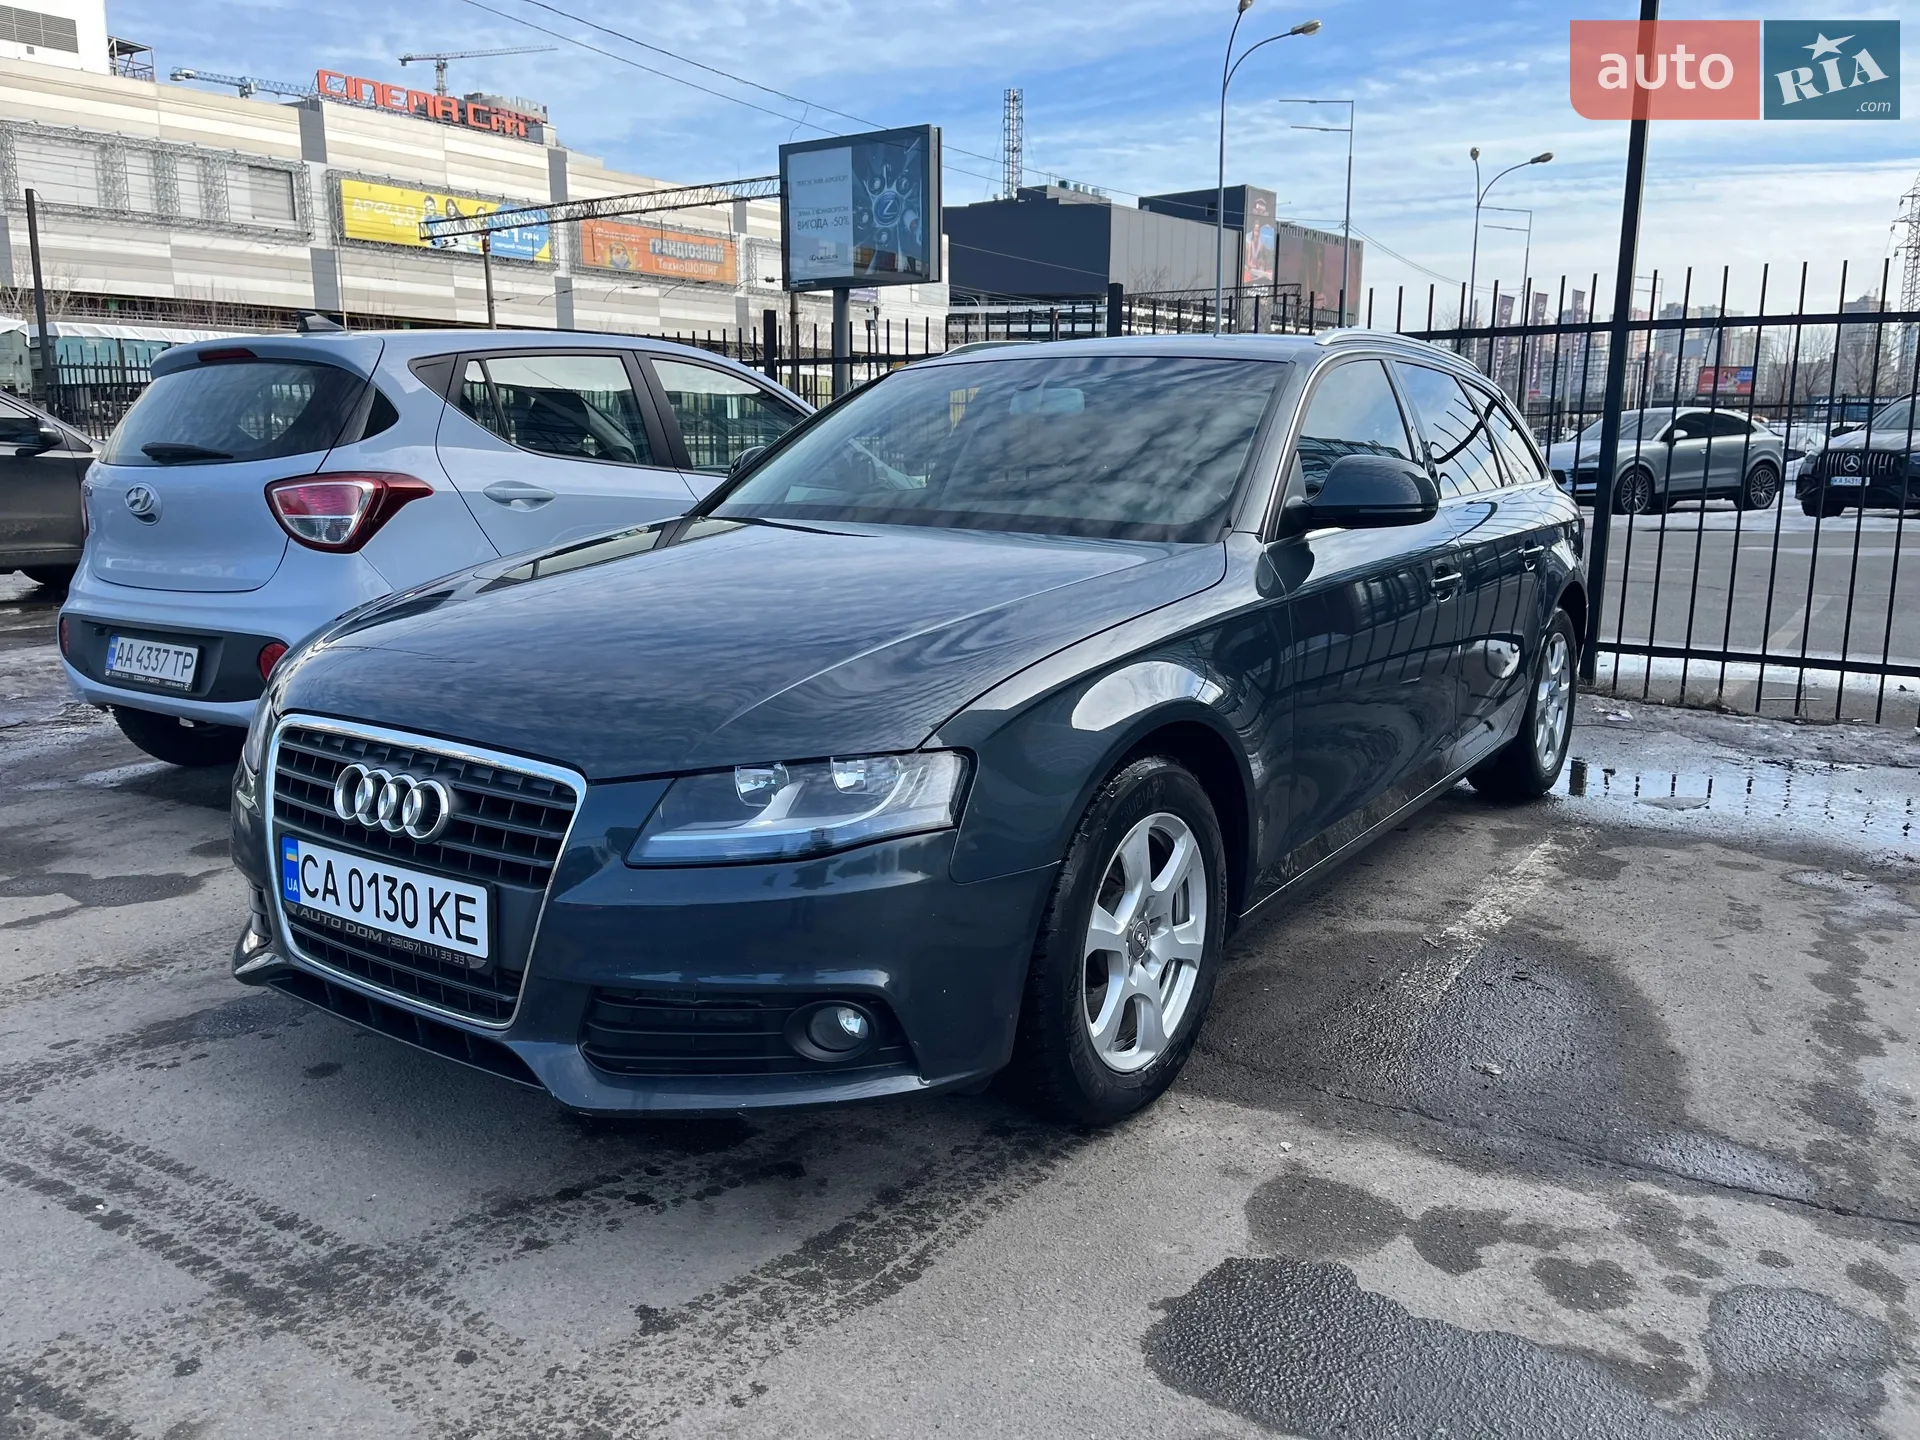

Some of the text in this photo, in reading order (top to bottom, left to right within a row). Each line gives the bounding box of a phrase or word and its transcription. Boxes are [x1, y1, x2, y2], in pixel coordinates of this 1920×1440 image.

[317, 69, 459, 123] CINEMA
[353, 199, 417, 218] APOLLO
[797, 217, 829, 231] ВИГОДА
[115, 642, 194, 677] AA 4337 TP
[286, 877, 299, 892] UA
[301, 854, 478, 946] CA 0130 KE
[300, 906, 342, 929] AUTO
[345, 921, 383, 943] DOM
